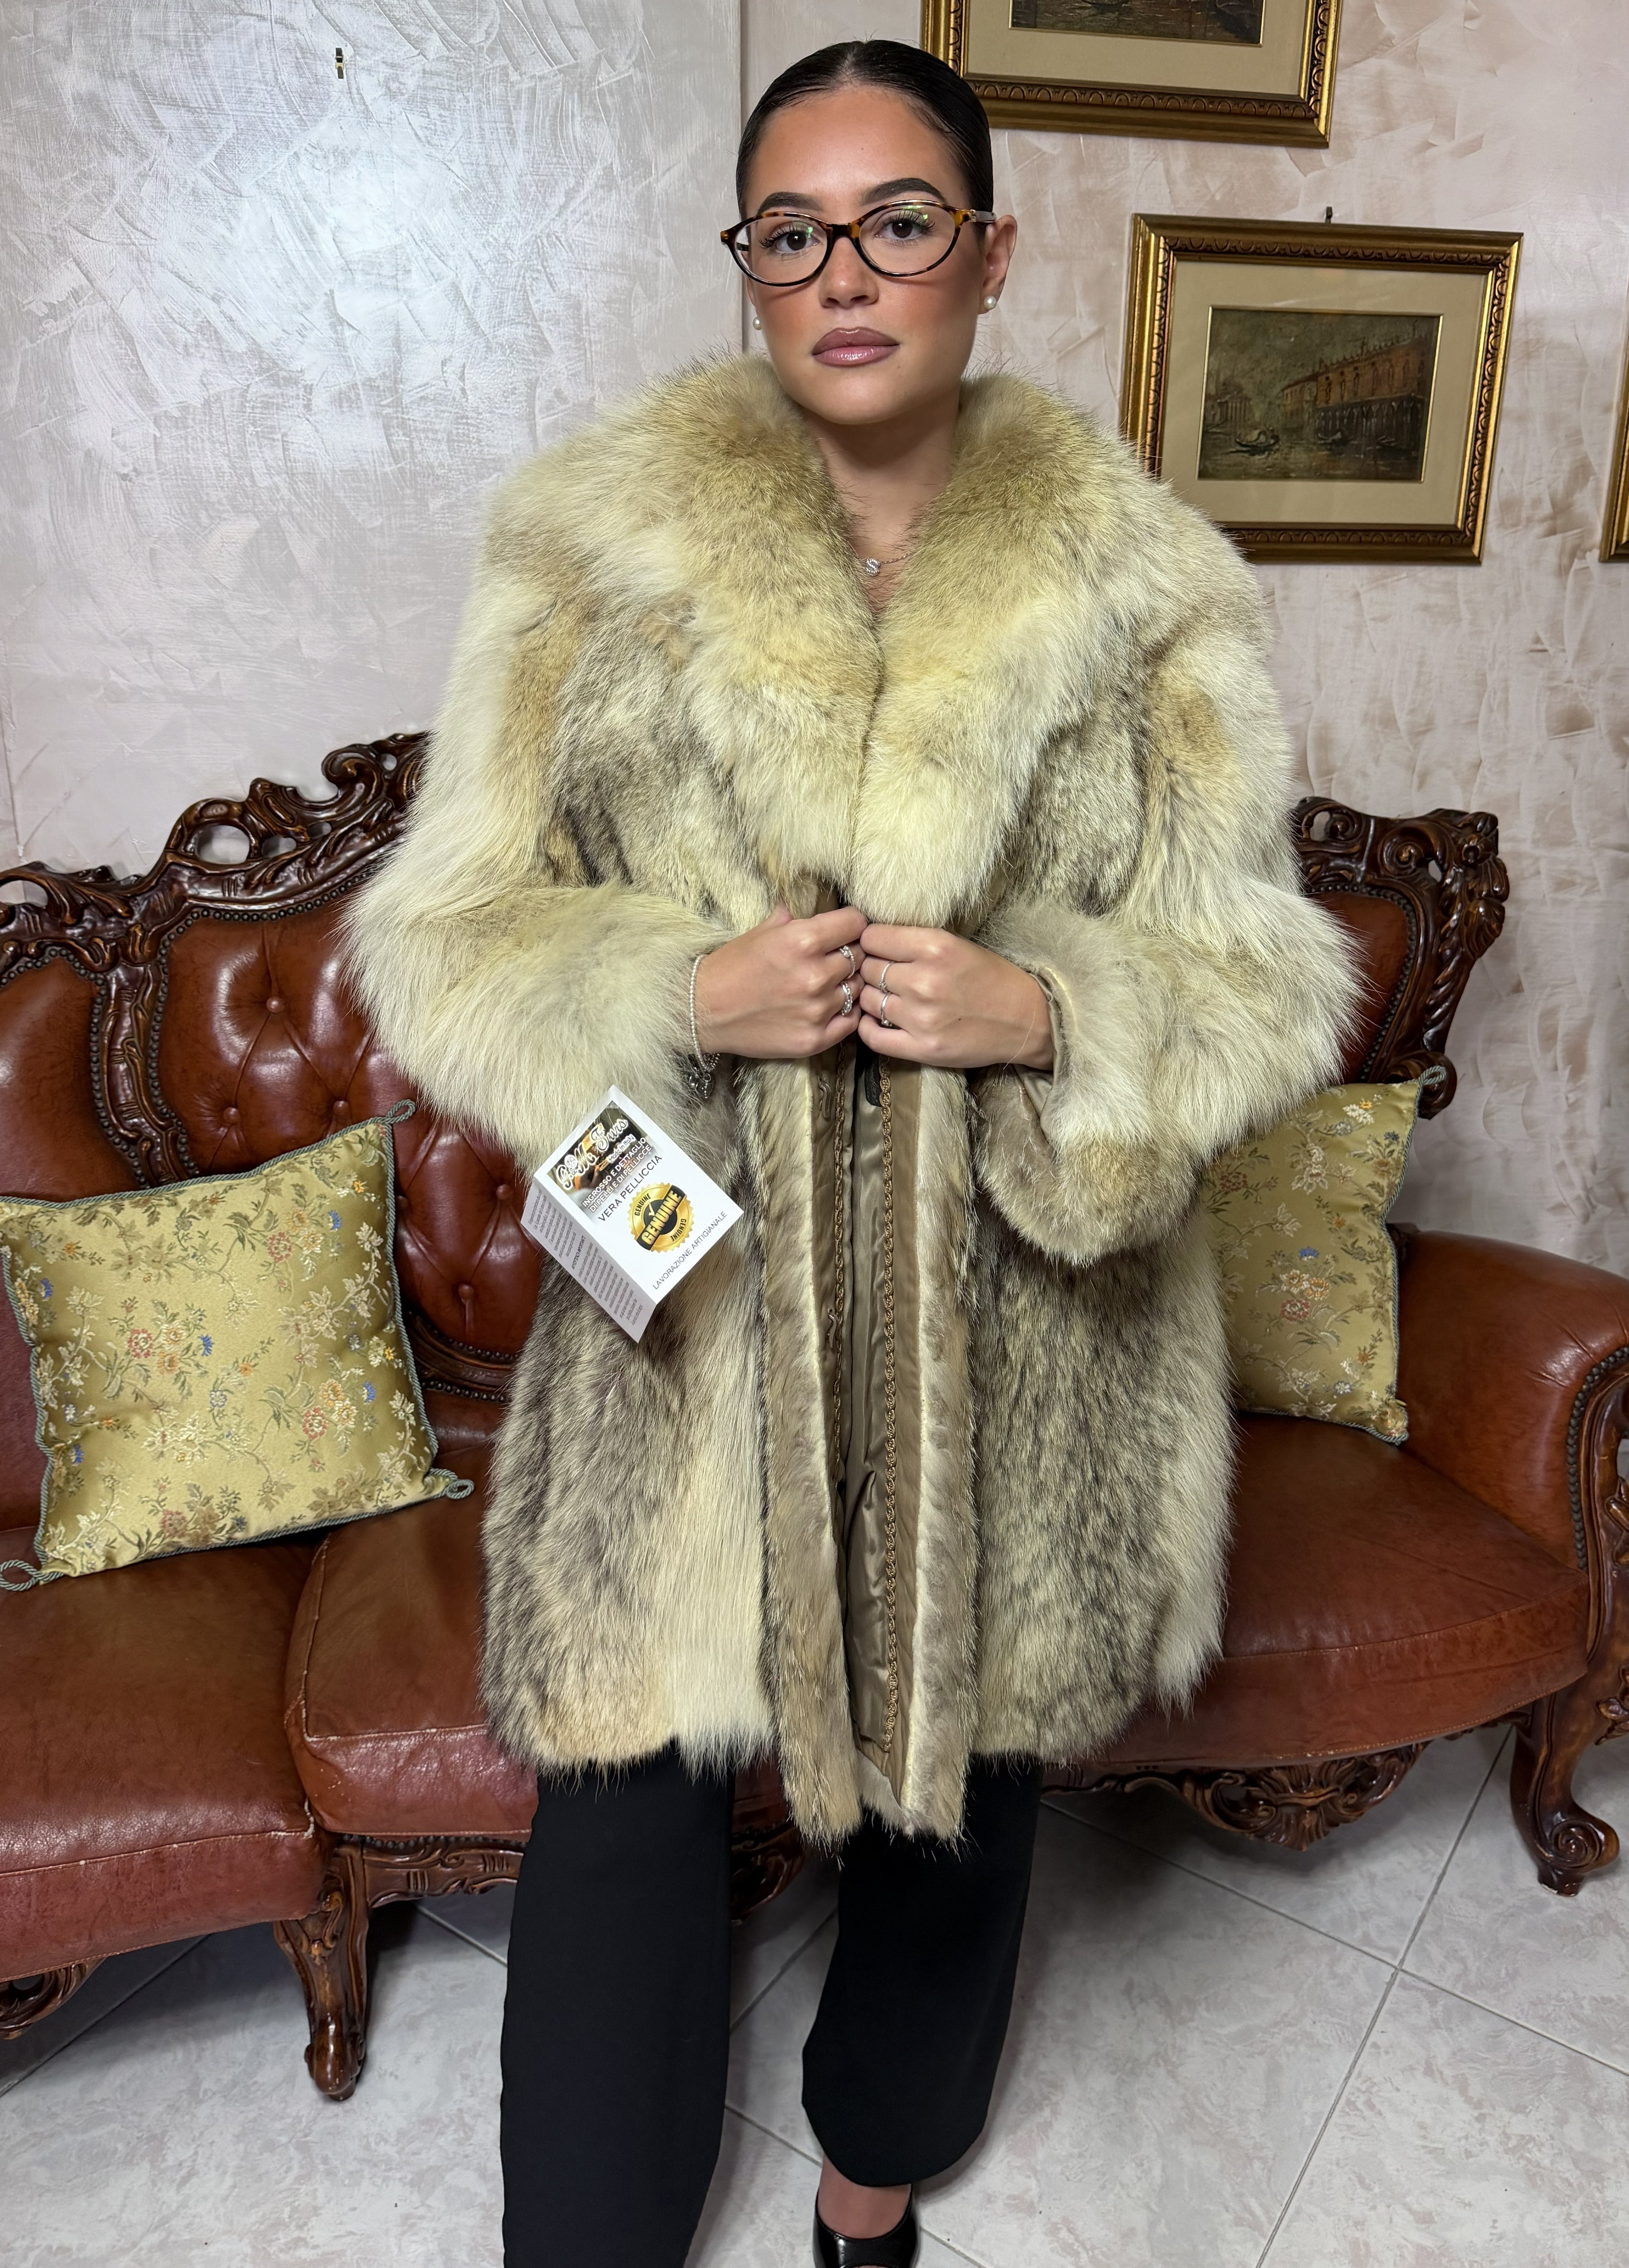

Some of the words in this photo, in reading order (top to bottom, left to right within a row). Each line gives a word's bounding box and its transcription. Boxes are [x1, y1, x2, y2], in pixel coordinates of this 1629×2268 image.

[590, 1119, 628, 1152] Furs
[609, 1150, 621, 1162] Made
[582, 1175, 612, 1207] INGROSSO
[615, 1137, 646, 1171] DETTAGLIO
[589, 1202, 598, 1212] DI
[596, 1186, 614, 1205] PELLI
[616, 1174, 625, 1183] DI
[623, 1145, 652, 1176] PELLICCE
[598, 1199, 622, 1222] VERA
[620, 1155, 662, 1199] PELLICCIA
[634, 1193, 651, 1216] GENUINE
[641, 1190, 682, 1244] GENUINE
[670, 1219, 686, 1241] GENUINE
[653, 1248, 692, 1290] LAVORAZIONE
[692, 1211, 727, 1252] ARTIGIANALE
